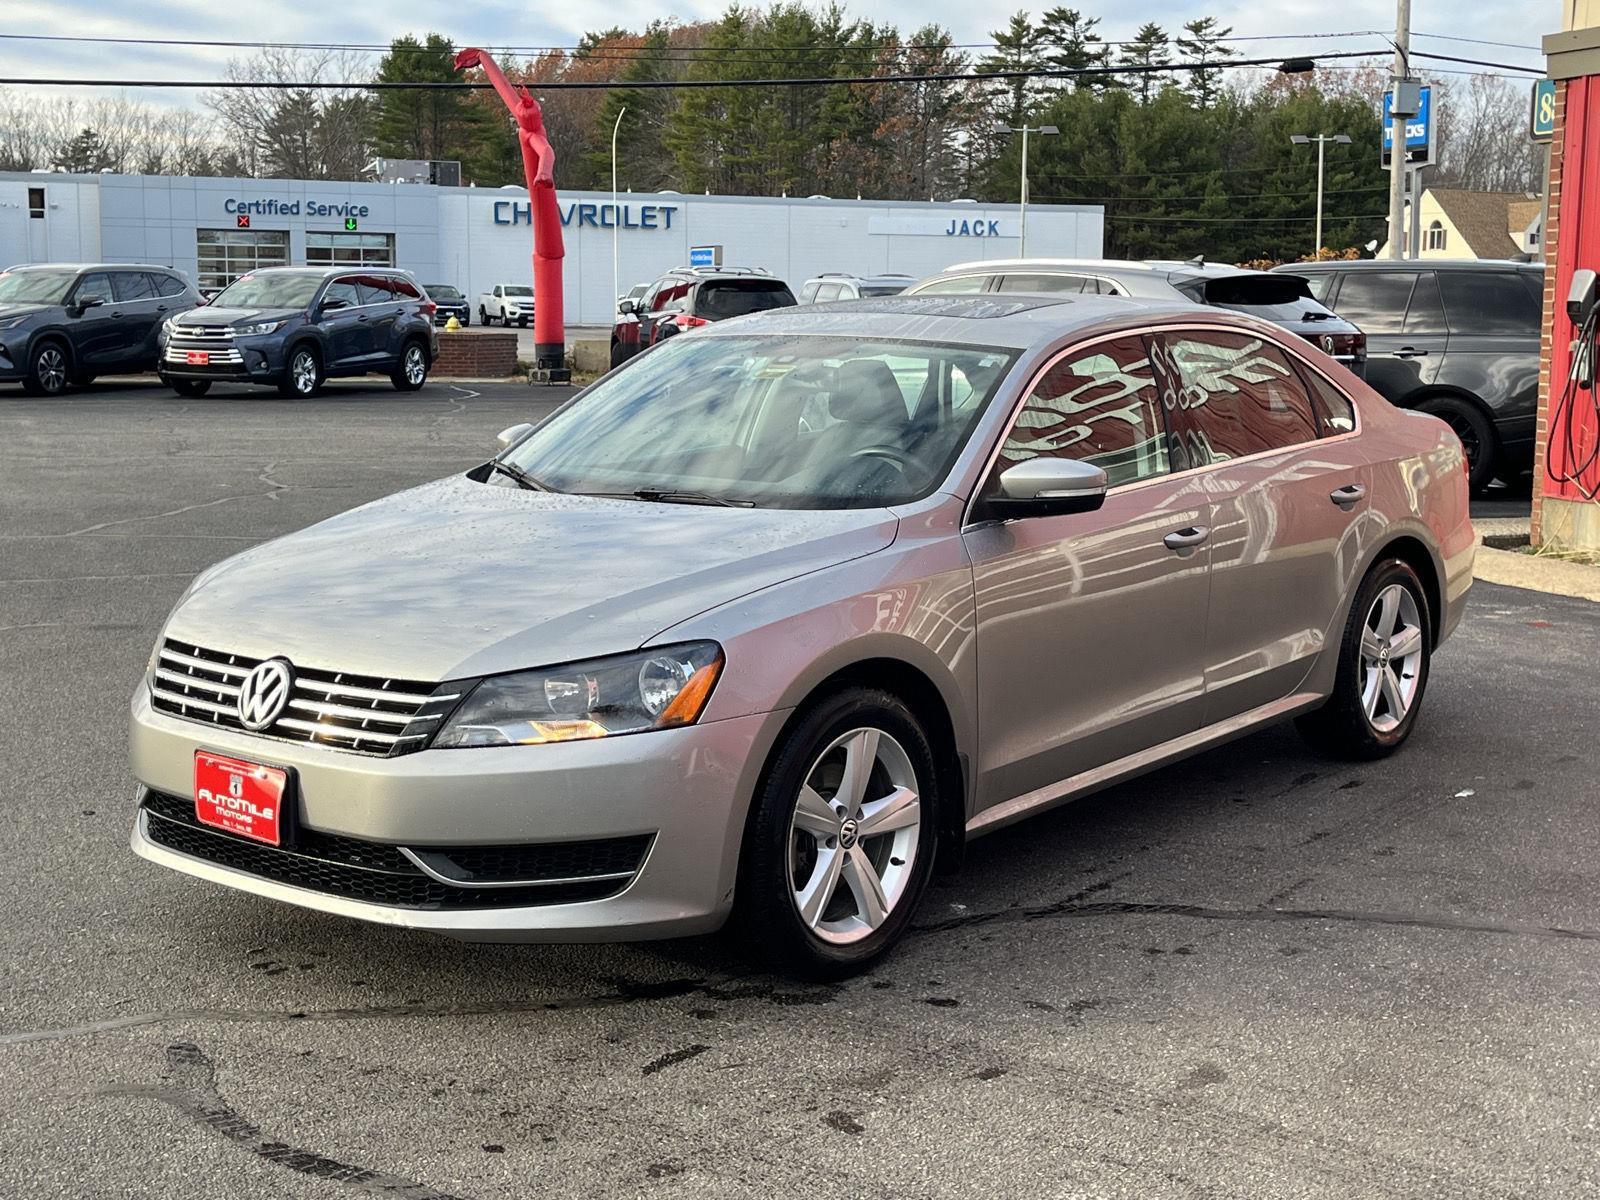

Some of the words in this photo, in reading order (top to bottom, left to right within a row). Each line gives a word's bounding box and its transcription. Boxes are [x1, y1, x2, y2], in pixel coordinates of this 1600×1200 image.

[1384, 123, 1425, 140] TCKS
[224, 198, 300, 216] Certified
[306, 201, 369, 217] Service
[493, 200, 678, 230] CHVROLET
[946, 219, 1000, 237] JACK
